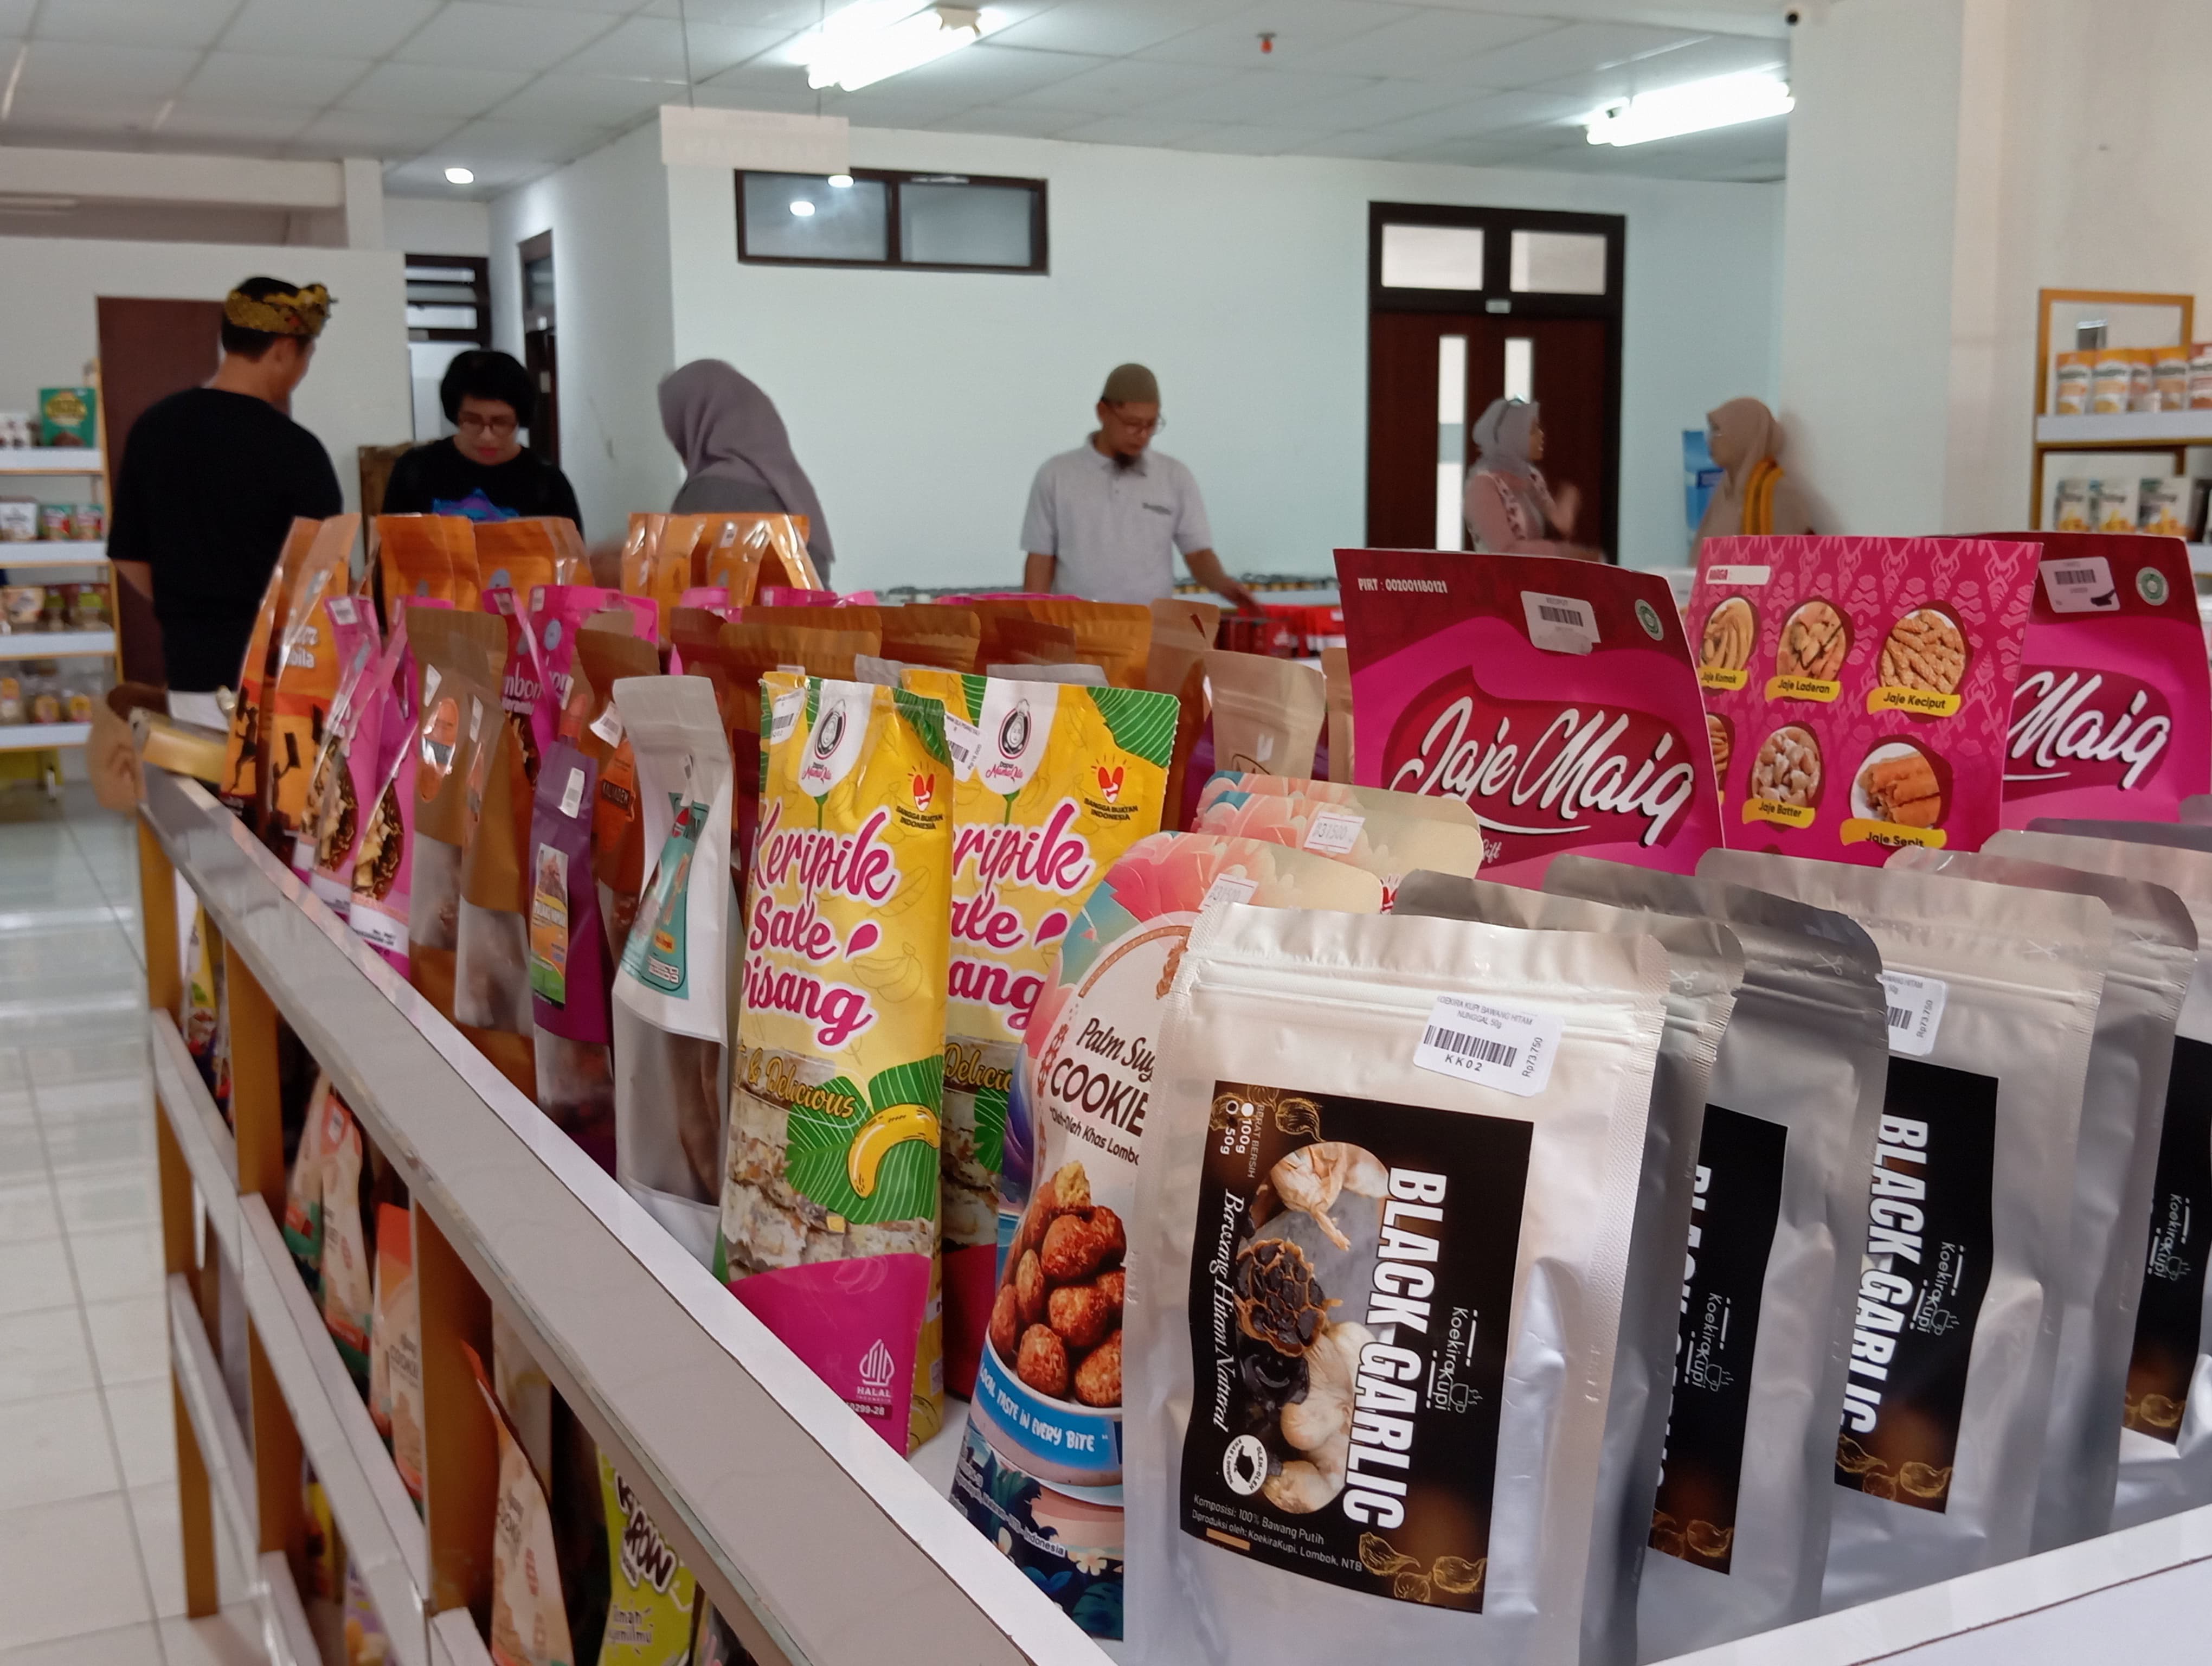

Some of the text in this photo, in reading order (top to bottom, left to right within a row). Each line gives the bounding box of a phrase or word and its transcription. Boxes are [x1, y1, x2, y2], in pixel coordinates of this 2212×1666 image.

[1358, 578, 1378, 591] PIRT
[1778, 680, 1830, 694] Jaje Laderan
[1883, 691, 1946, 709] Jaje Keciput
[1390, 696, 1518, 800] Jaje
[899, 818, 936, 830] INDONESIA
[1084, 798, 1110, 813] BANGGA
[1091, 809, 1131, 821] INDONESIA
[1758, 802, 1802, 817] Jaje Batter
[952, 803, 1090, 897] ripik
[750, 895, 837, 960] Sale
[948, 960, 1046, 1030] ang
[1481, 1006, 1510, 1020] BAWANG
[1510, 1014, 1533, 1026] HITAM
[1076, 1017, 1126, 1061] Palm
[1522, 1037, 1544, 1078] Rp73.750
[766, 1057, 856, 1118] Delicious
[1051, 1058, 1149, 1138] COOKIE
[1082, 1125, 1107, 1149] Khas
[1220, 1126, 1236, 1155] 50g
[1235, 1119, 1253, 1154] 100g
[1247, 1104, 1265, 1178] BERAT BERSIH
[1867, 1114, 1928, 1265] BLACK
[1342, 1167, 1447, 1530] BLACK GARLIC
[857, 1386, 891, 1398] HALAL
[996, 1389, 1020, 1421] TASTE
[1031, 1418, 1063, 1446] EVERY
[1192, 1509, 1228, 1529] Diproduksi
[1229, 1523, 1248, 1537] oleh:
[1341, 1558, 1362, 1572] NTB
[1194, 1494, 1324, 1545] Komposisi: 100% Bawang Putih
